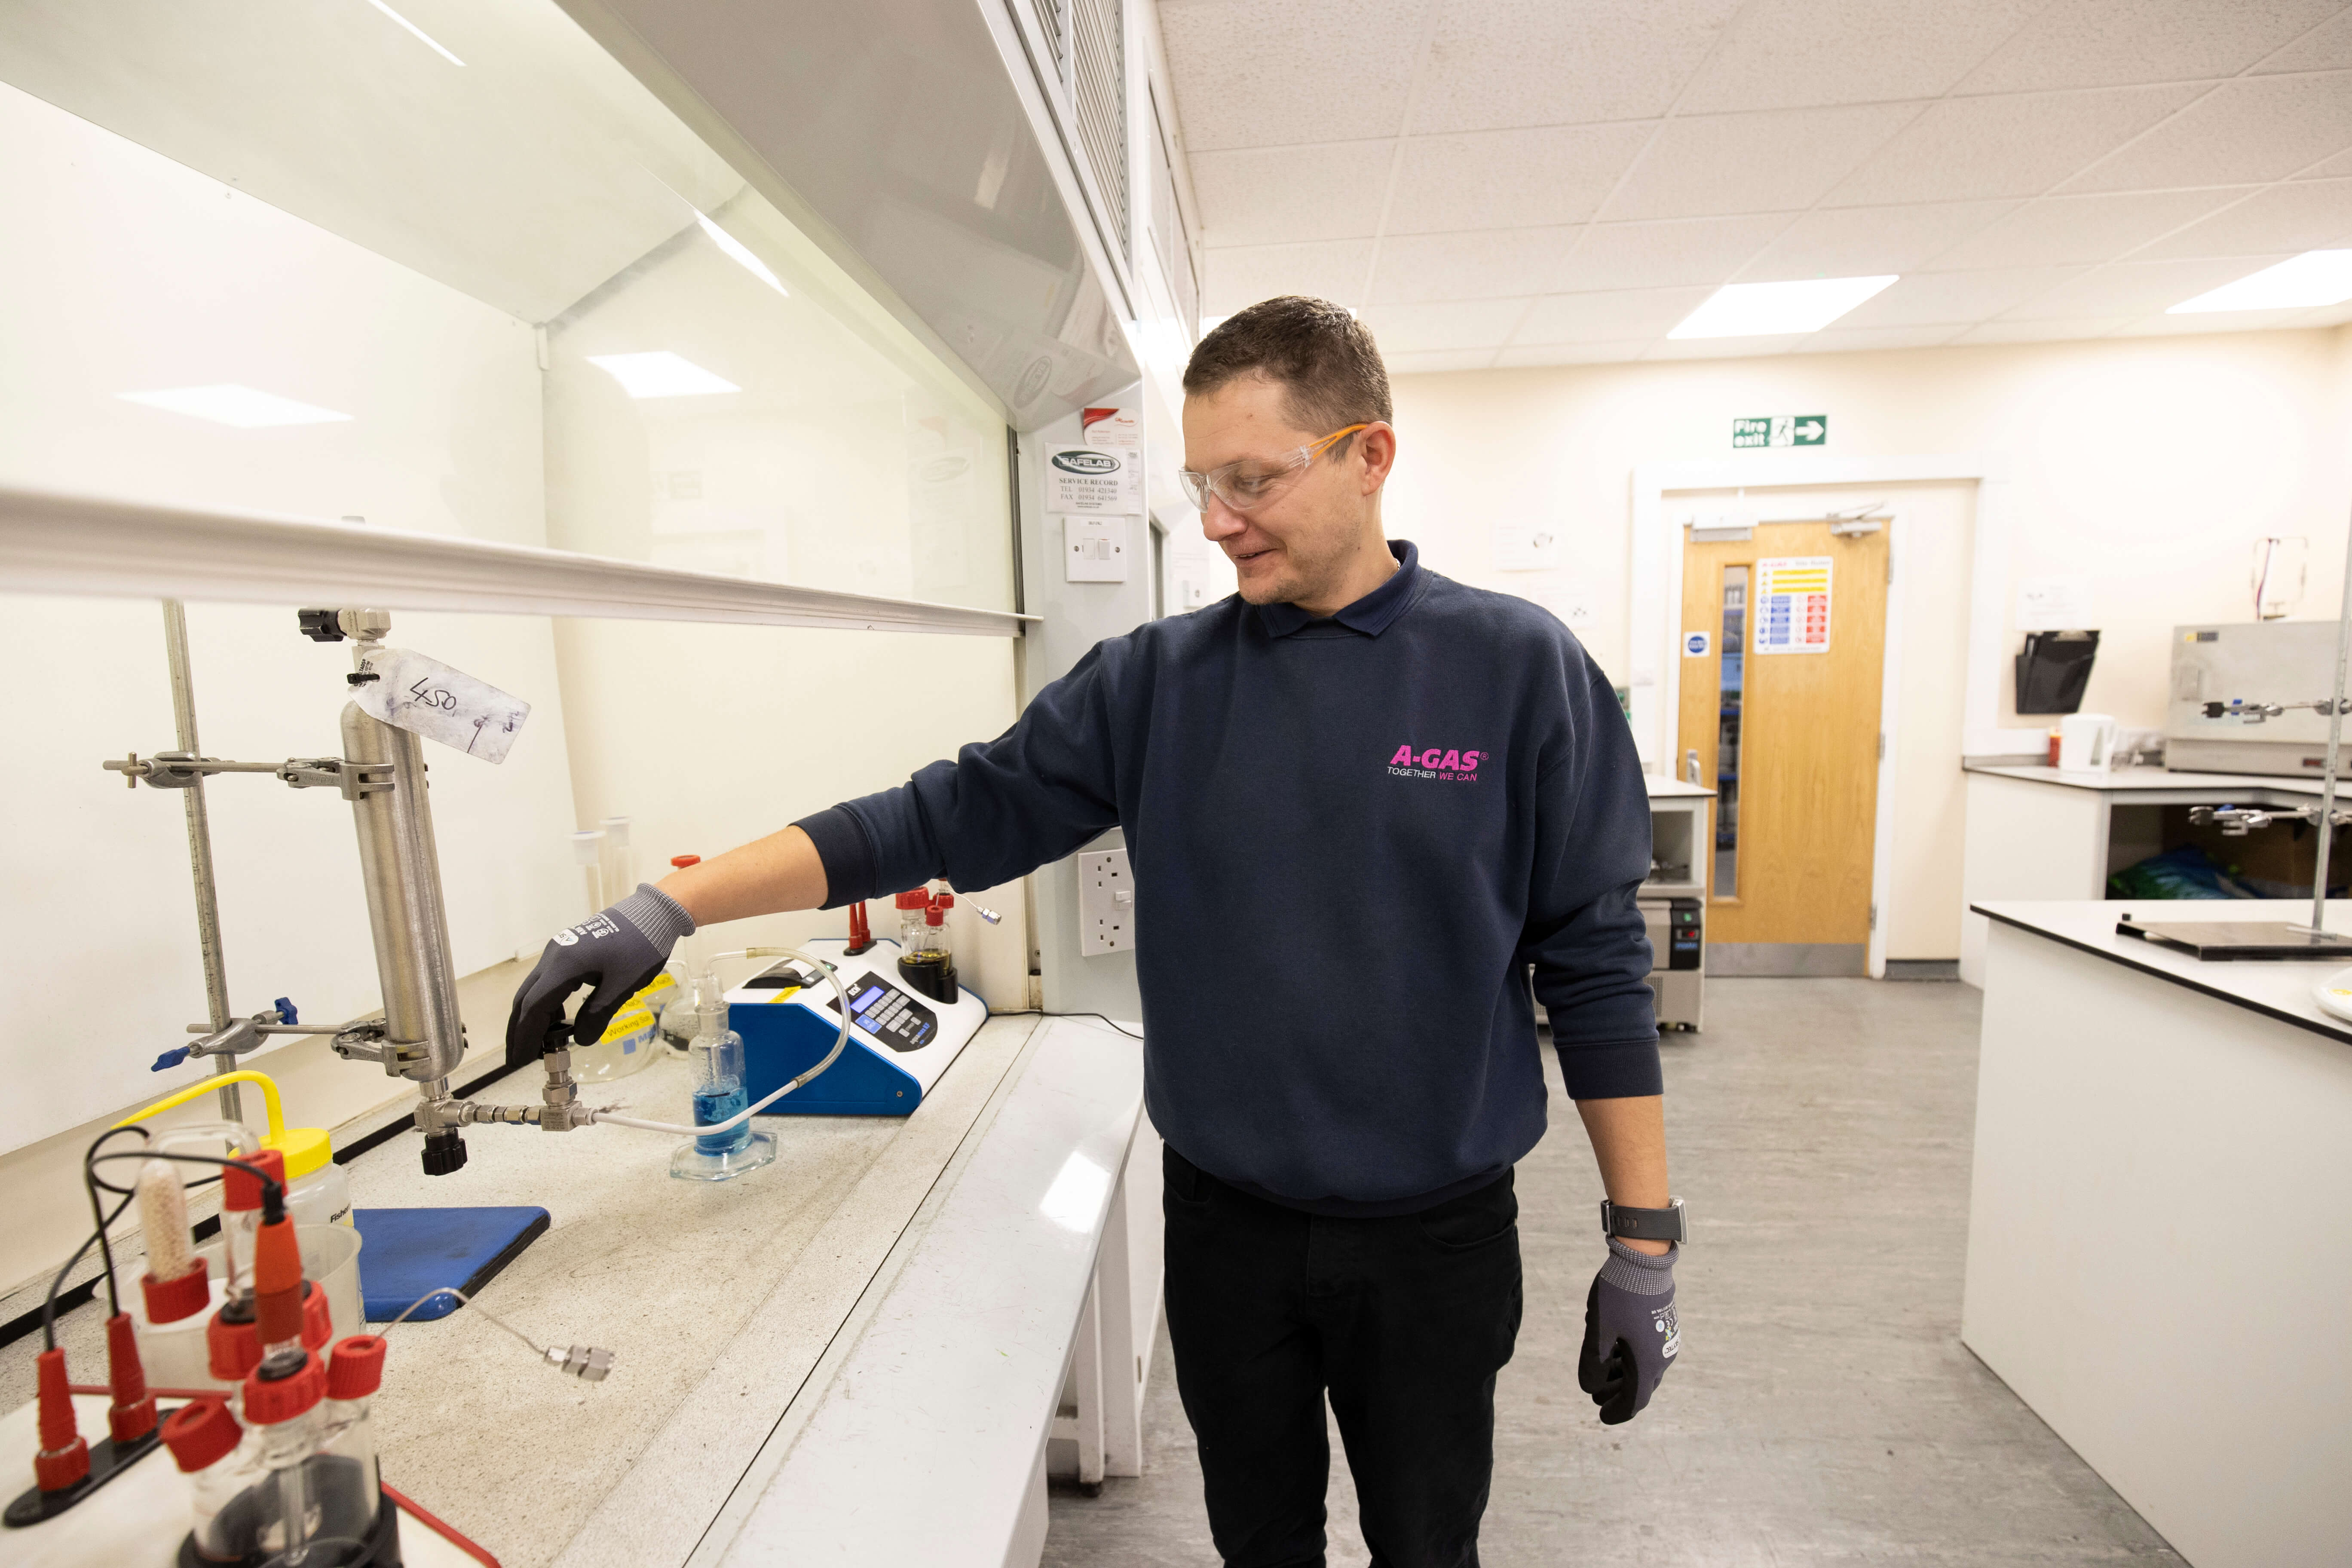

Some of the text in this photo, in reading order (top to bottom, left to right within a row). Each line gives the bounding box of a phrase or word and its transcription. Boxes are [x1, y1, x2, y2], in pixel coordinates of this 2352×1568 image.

[1734, 420, 1767, 434] Fire
[1734, 432, 1765, 447] exit
[1061, 457, 1111, 467] SAFELAB
[410, 677, 457, 710] 450
[1387, 766, 1477, 781] TOGETHER WE CAN
[606, 1019, 640, 1037] Working
